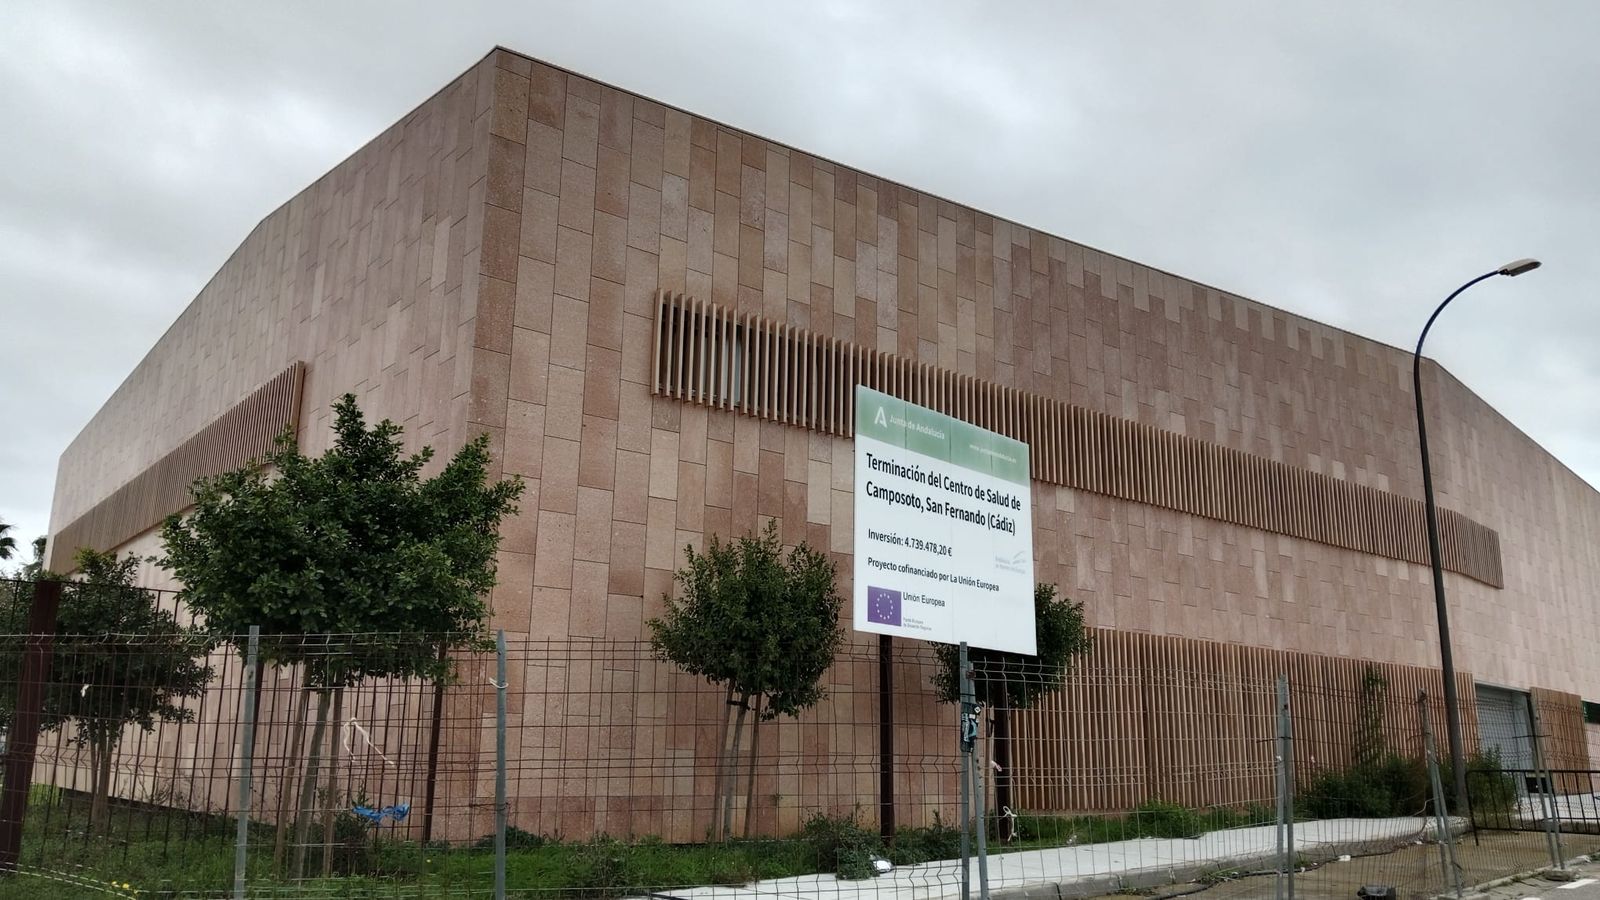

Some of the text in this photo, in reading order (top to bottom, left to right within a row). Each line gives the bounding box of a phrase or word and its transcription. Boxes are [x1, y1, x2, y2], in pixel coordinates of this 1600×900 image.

[867, 453, 1021, 511] Terminación del Centro de Salud de
[866, 481, 1015, 536] Camposoto, San Fernando (Cádiz)
[868, 529, 952, 557] Inversión: 4.739.478,20 €
[868, 557, 999, 592] Proyecto cofinanciado por La Unión Europea
[903, 592, 945, 607] Unión Europea
